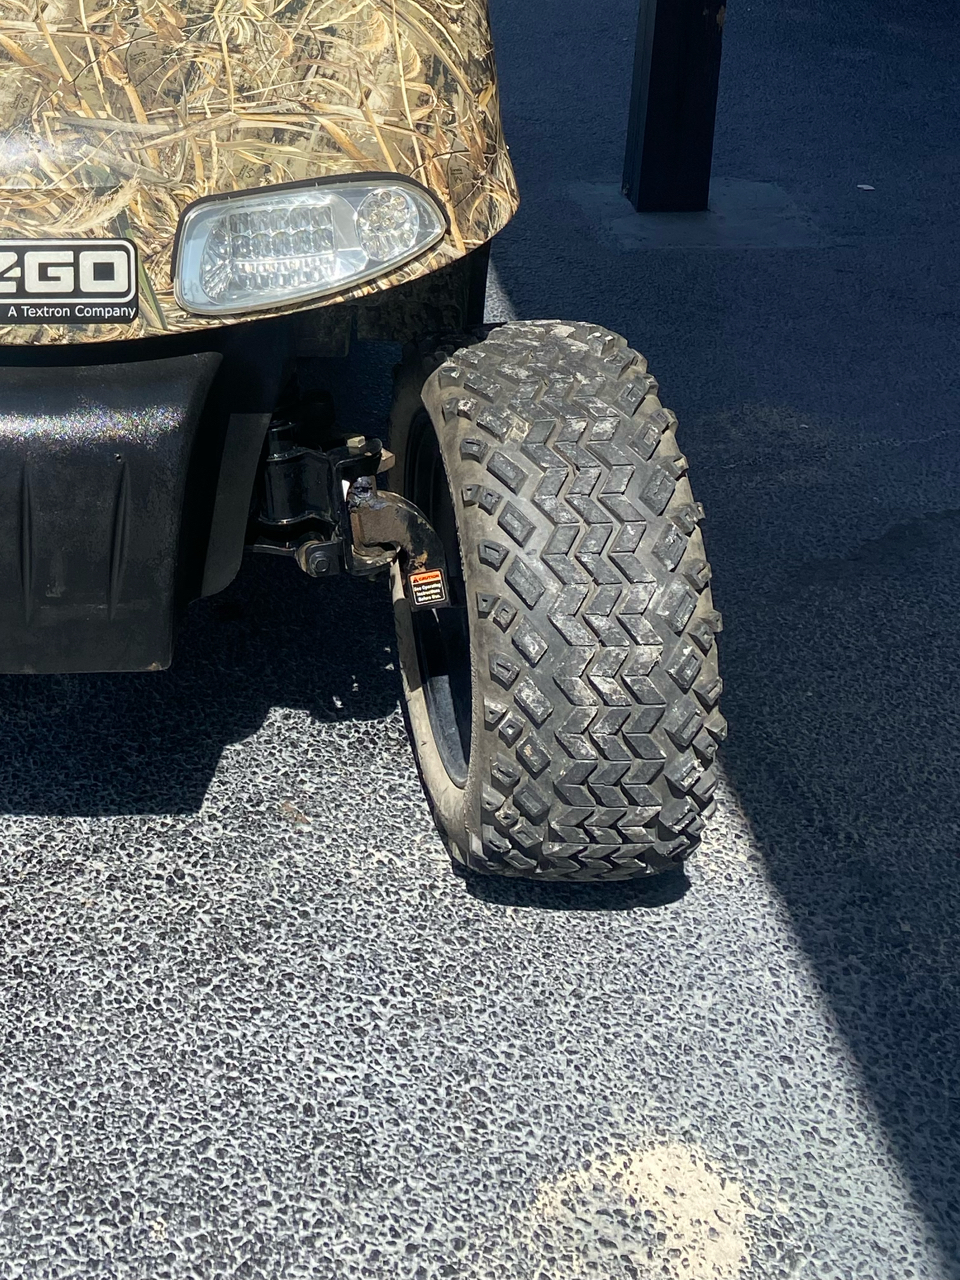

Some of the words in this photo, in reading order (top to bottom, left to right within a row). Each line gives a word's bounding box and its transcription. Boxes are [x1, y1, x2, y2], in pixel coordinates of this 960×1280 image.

[8, 306, 17, 317] A
[21, 305, 70, 317] Textron
[75, 305, 136, 319] Company
